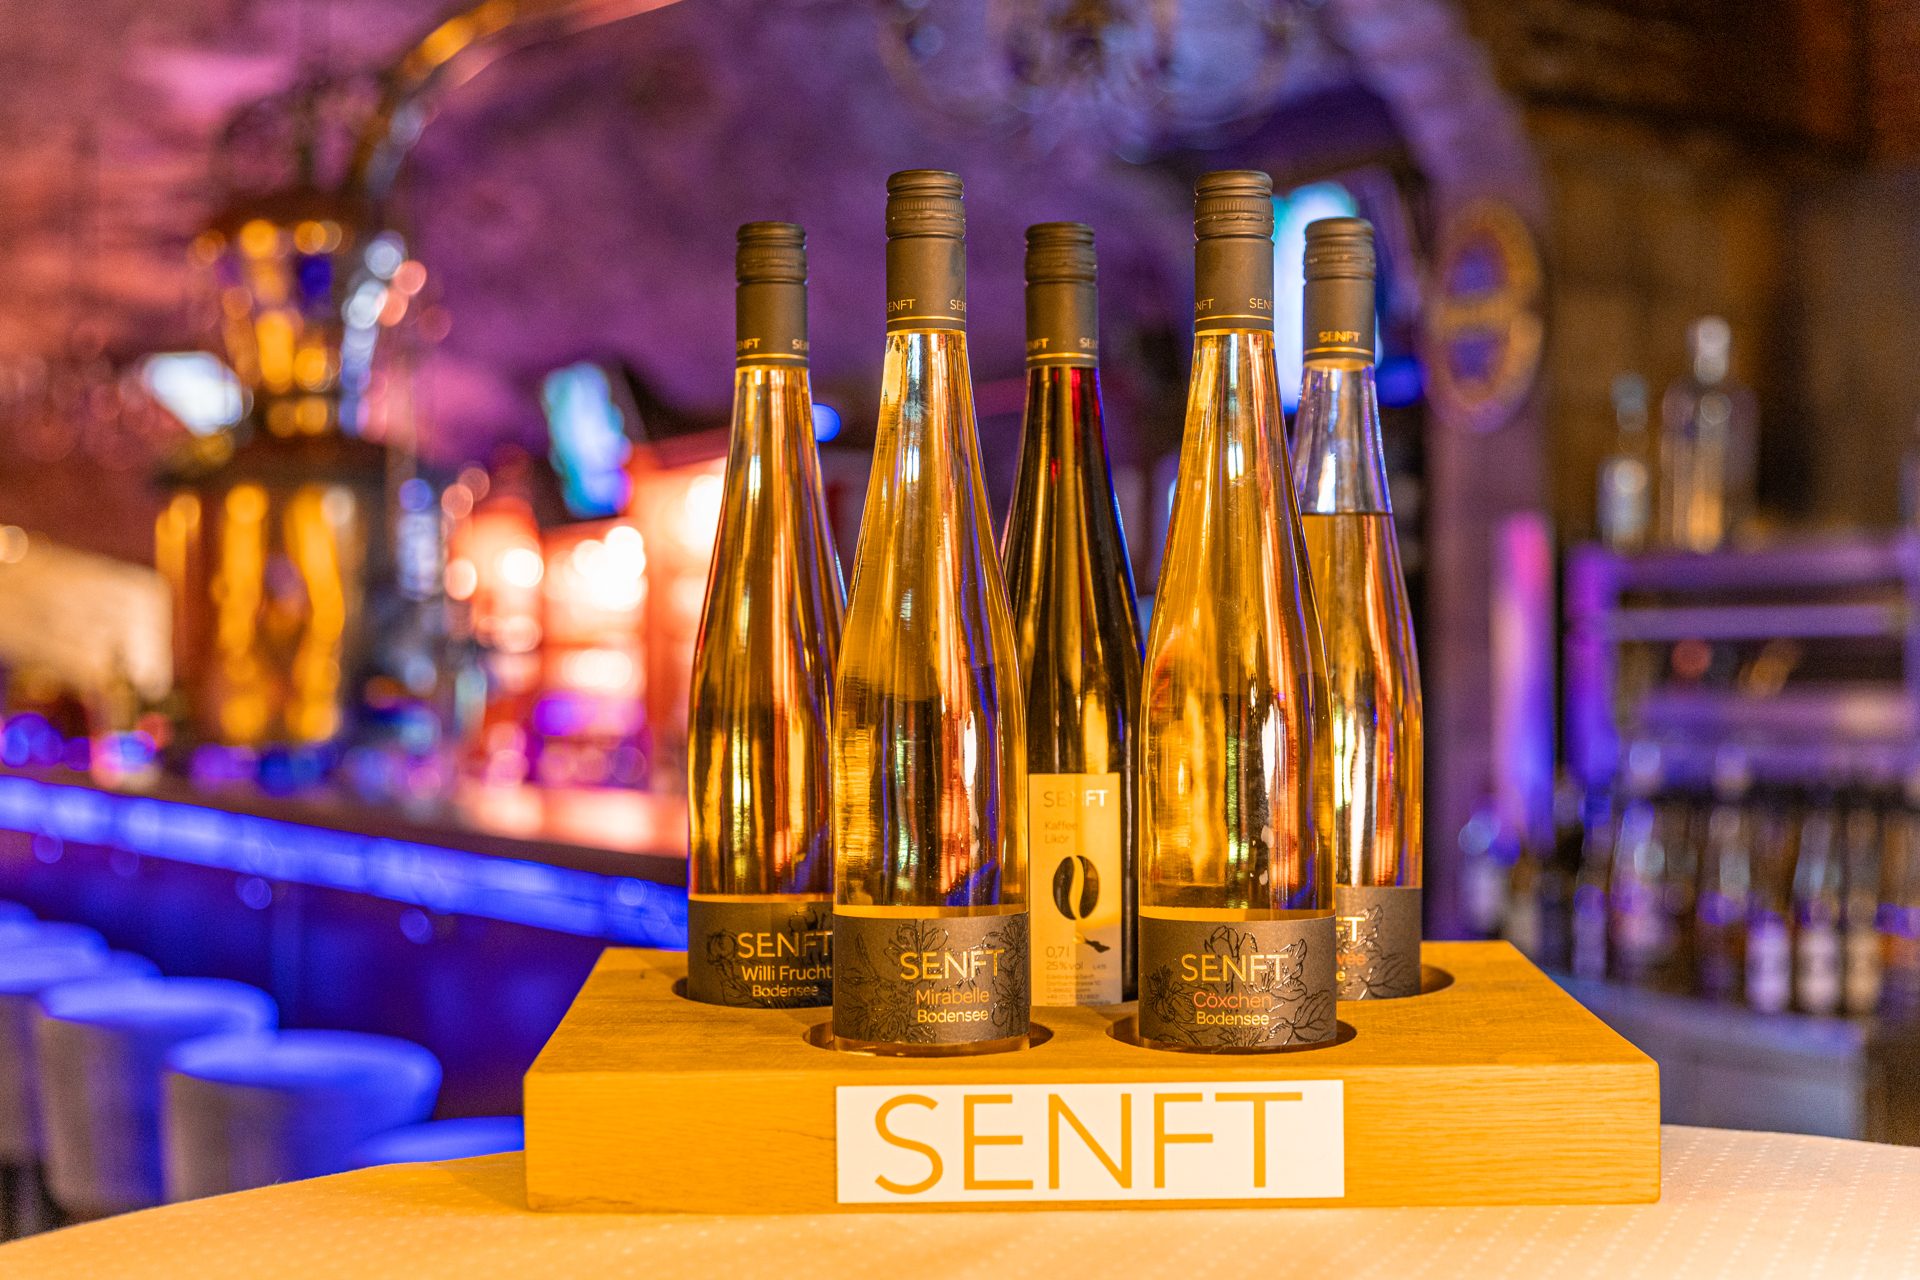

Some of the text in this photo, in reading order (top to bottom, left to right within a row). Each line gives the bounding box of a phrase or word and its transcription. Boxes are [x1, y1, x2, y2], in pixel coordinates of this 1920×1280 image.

[1318, 330, 1361, 343] SENFT
[737, 930, 833, 959] SENFT
[741, 964, 832, 981] Willi Frucht
[900, 949, 1005, 980] SENFT
[1181, 953, 1289, 982] SENFT
[752, 983, 820, 998] Bodensee
[916, 988, 990, 1005] Mirabelle
[1193, 992, 1272, 1009] Cöxchen
[917, 1009, 989, 1024] Bodensee
[1196, 1011, 1270, 1026] Bodensee
[874, 1092, 1303, 1195] SENFT
